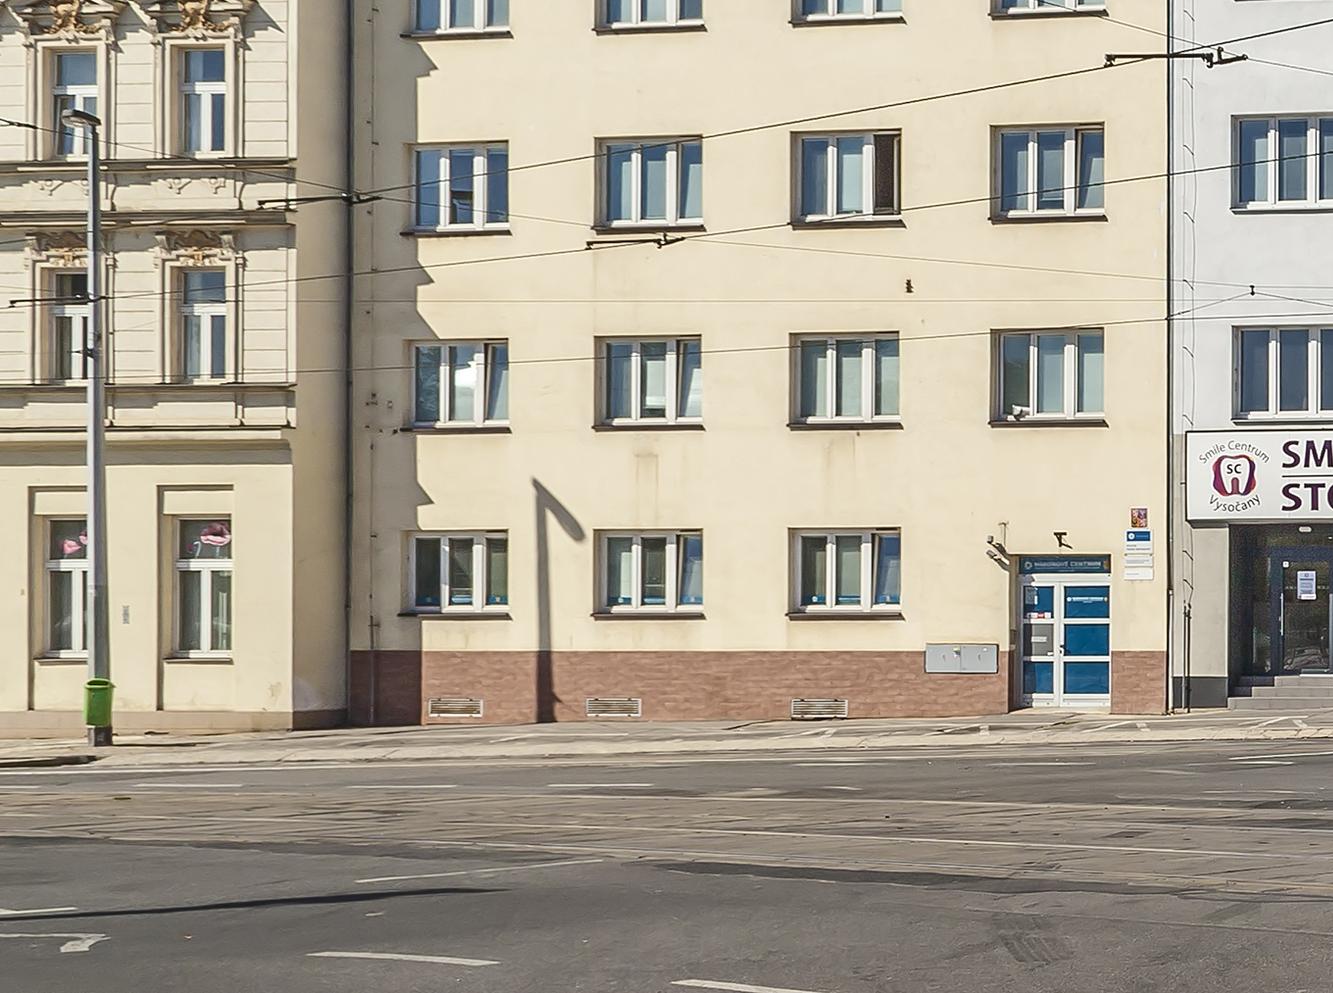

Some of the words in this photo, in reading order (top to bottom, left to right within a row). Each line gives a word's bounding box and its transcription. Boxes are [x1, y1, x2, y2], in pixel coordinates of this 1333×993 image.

[1200, 441, 1226, 464] Smile
[1228, 440, 1270, 463] Centrum
[1226, 463, 1242, 474] SC
[1209, 494, 1261, 512] Vysočany
